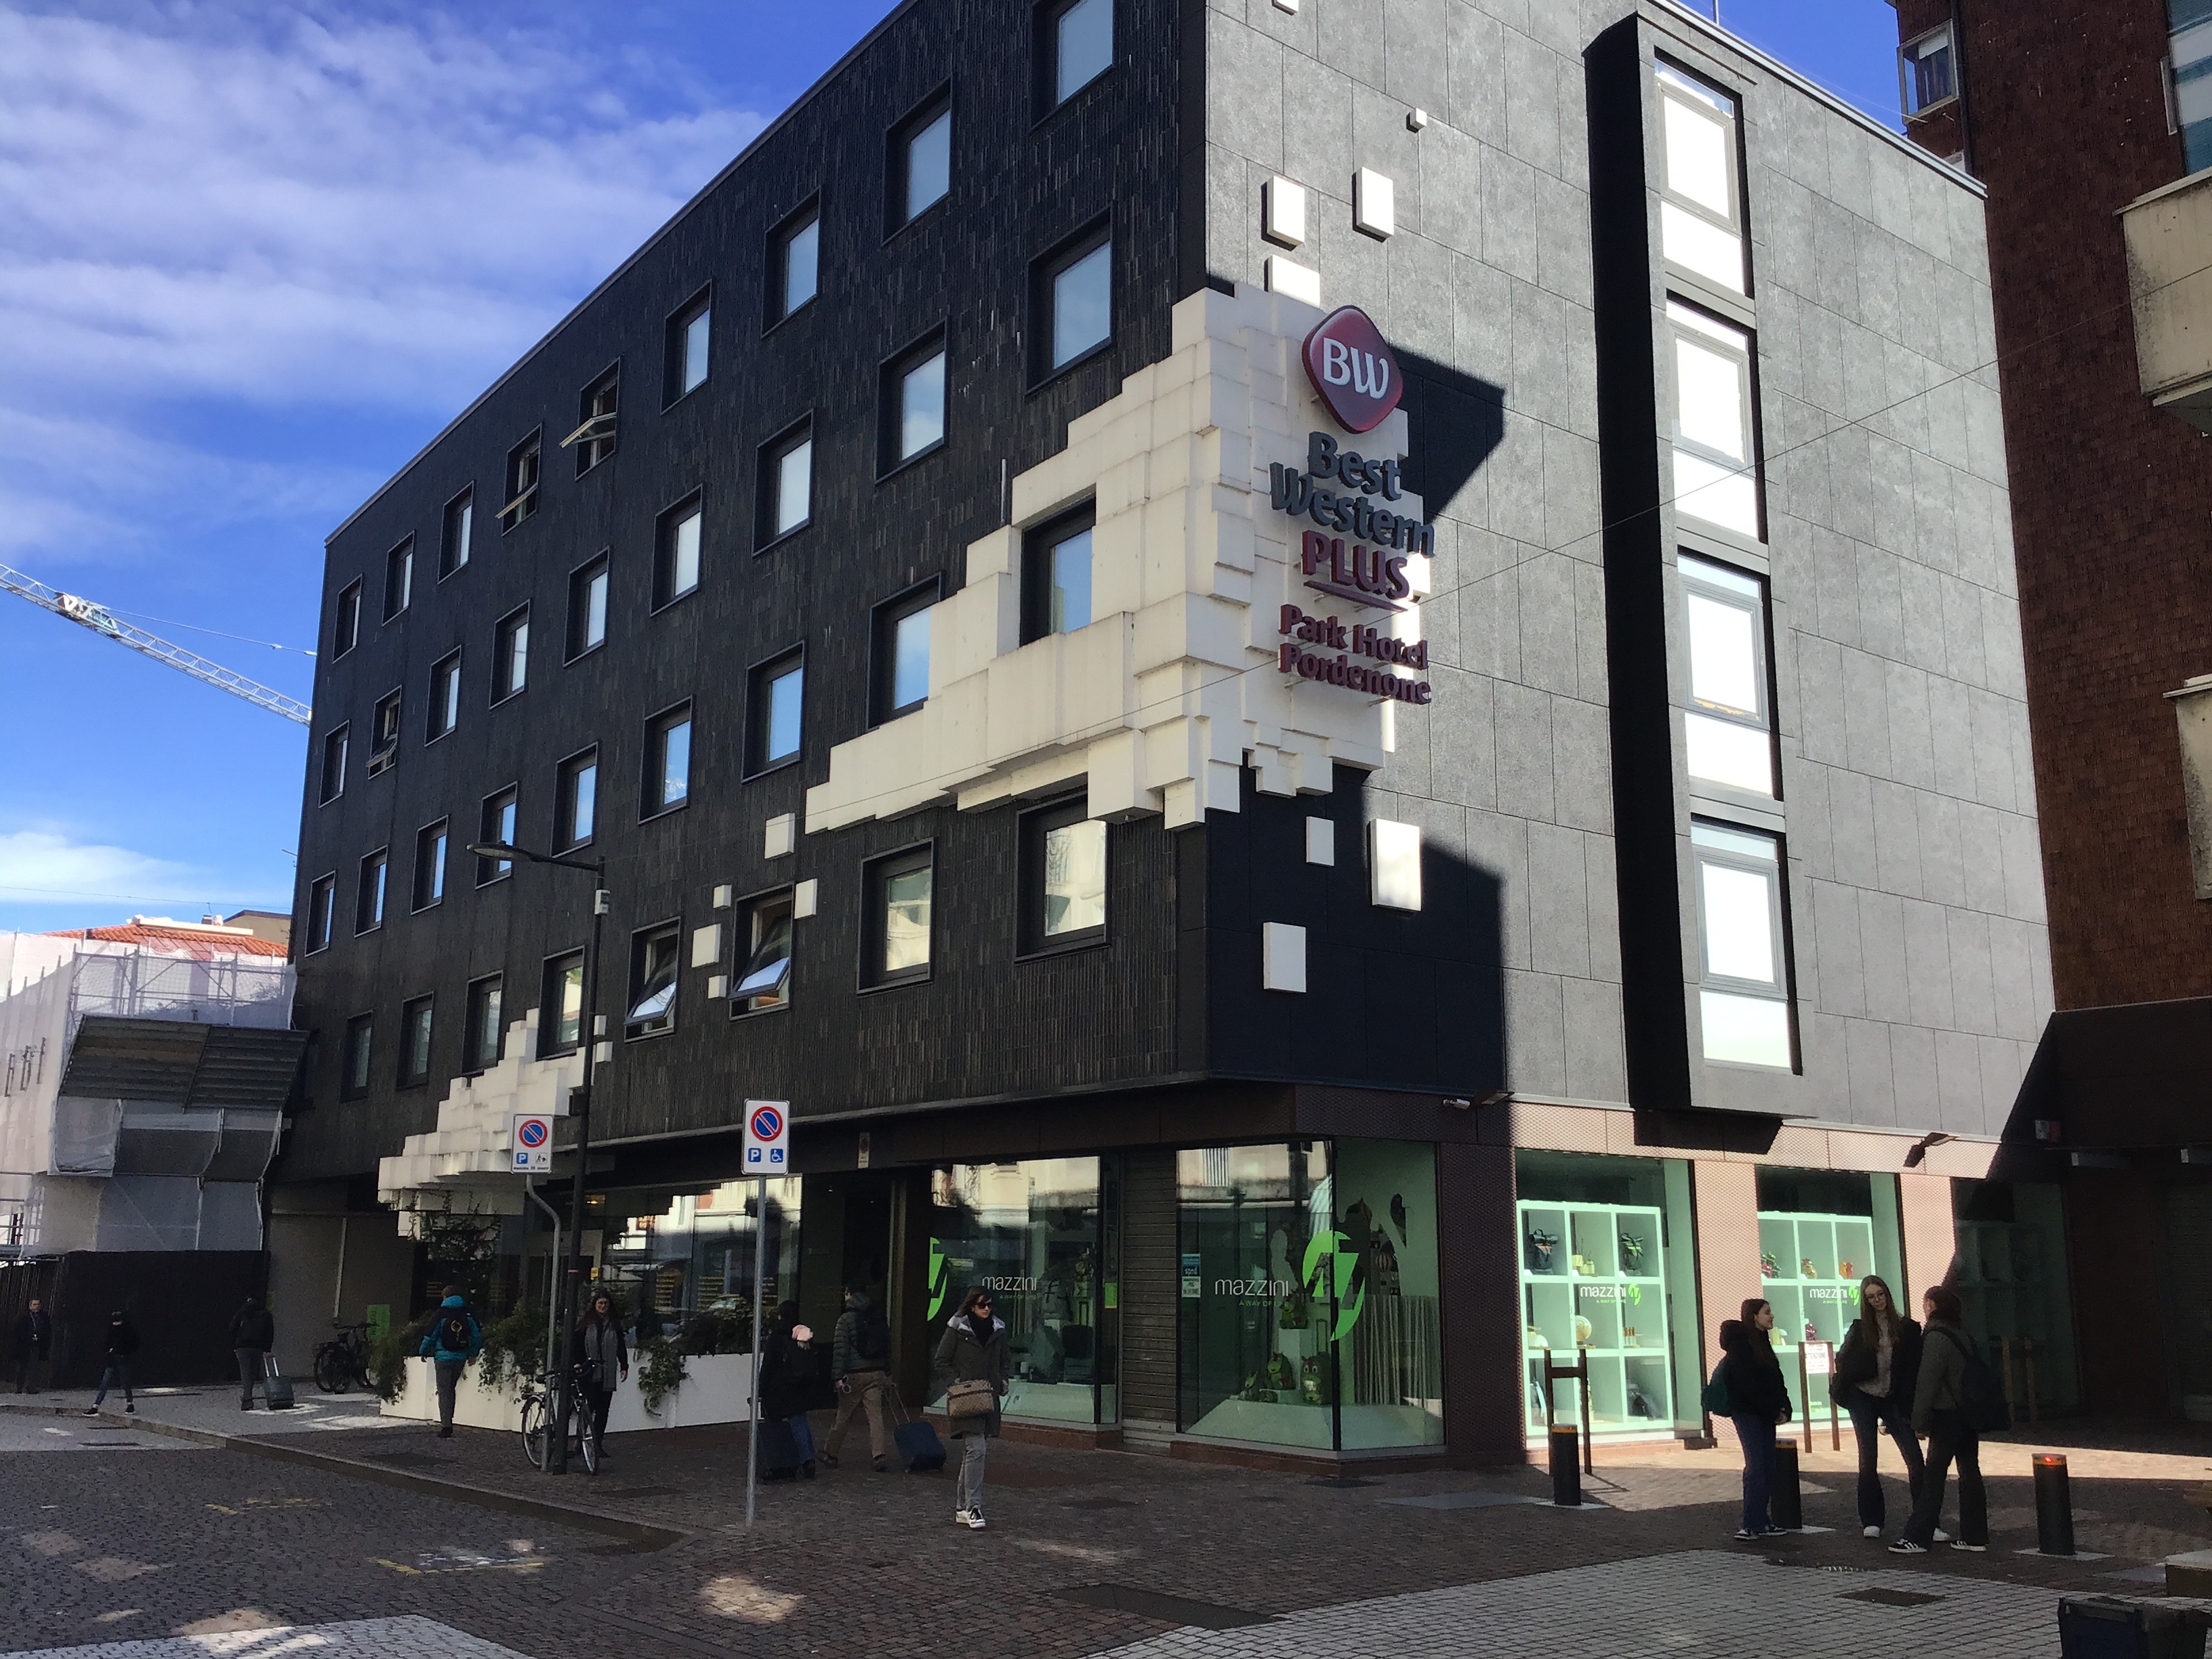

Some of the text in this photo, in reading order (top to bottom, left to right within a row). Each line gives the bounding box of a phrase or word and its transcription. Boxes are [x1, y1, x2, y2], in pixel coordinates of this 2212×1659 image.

[1323, 337, 1389, 400] BW
[1308, 431, 1401, 501] Best
[1270, 461, 1435, 558] Western
[1301, 530, 1410, 600] PLUS
[1279, 603, 1429, 671] Park Hotel
[1278, 642, 1431, 705] Pordenone
[518, 1153, 526, 1163] P
[751, 1150, 759, 1161] P
[982, 1276, 1037, 1290] mazzini
[1214, 1279, 1288, 1296] mazzini
[1580, 1286, 1626, 1297] mazzini
